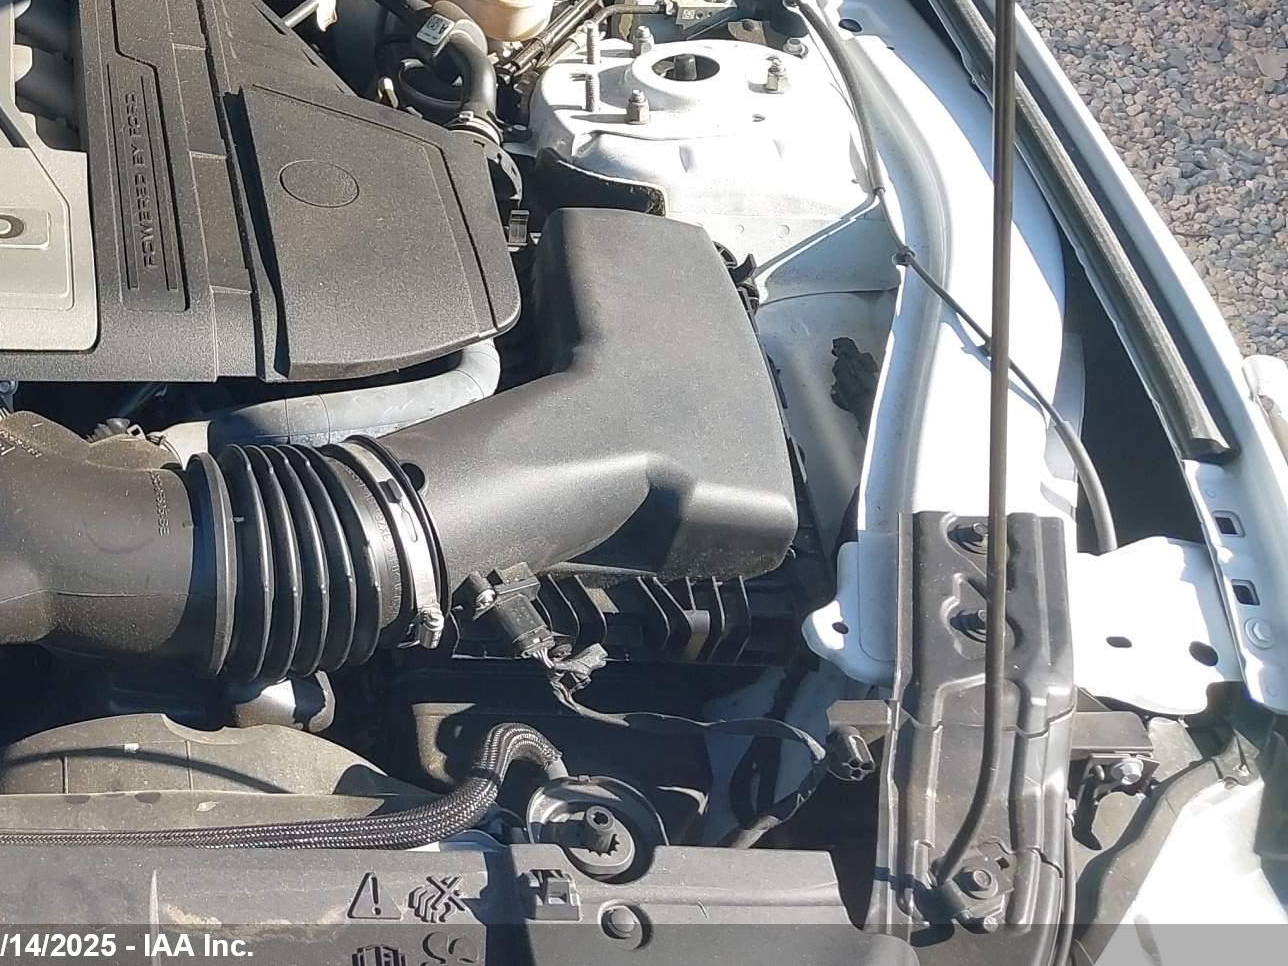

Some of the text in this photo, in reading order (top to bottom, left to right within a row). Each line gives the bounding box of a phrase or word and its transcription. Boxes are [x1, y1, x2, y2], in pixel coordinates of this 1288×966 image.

[124, 91, 157, 268] POWERED BY FORD
